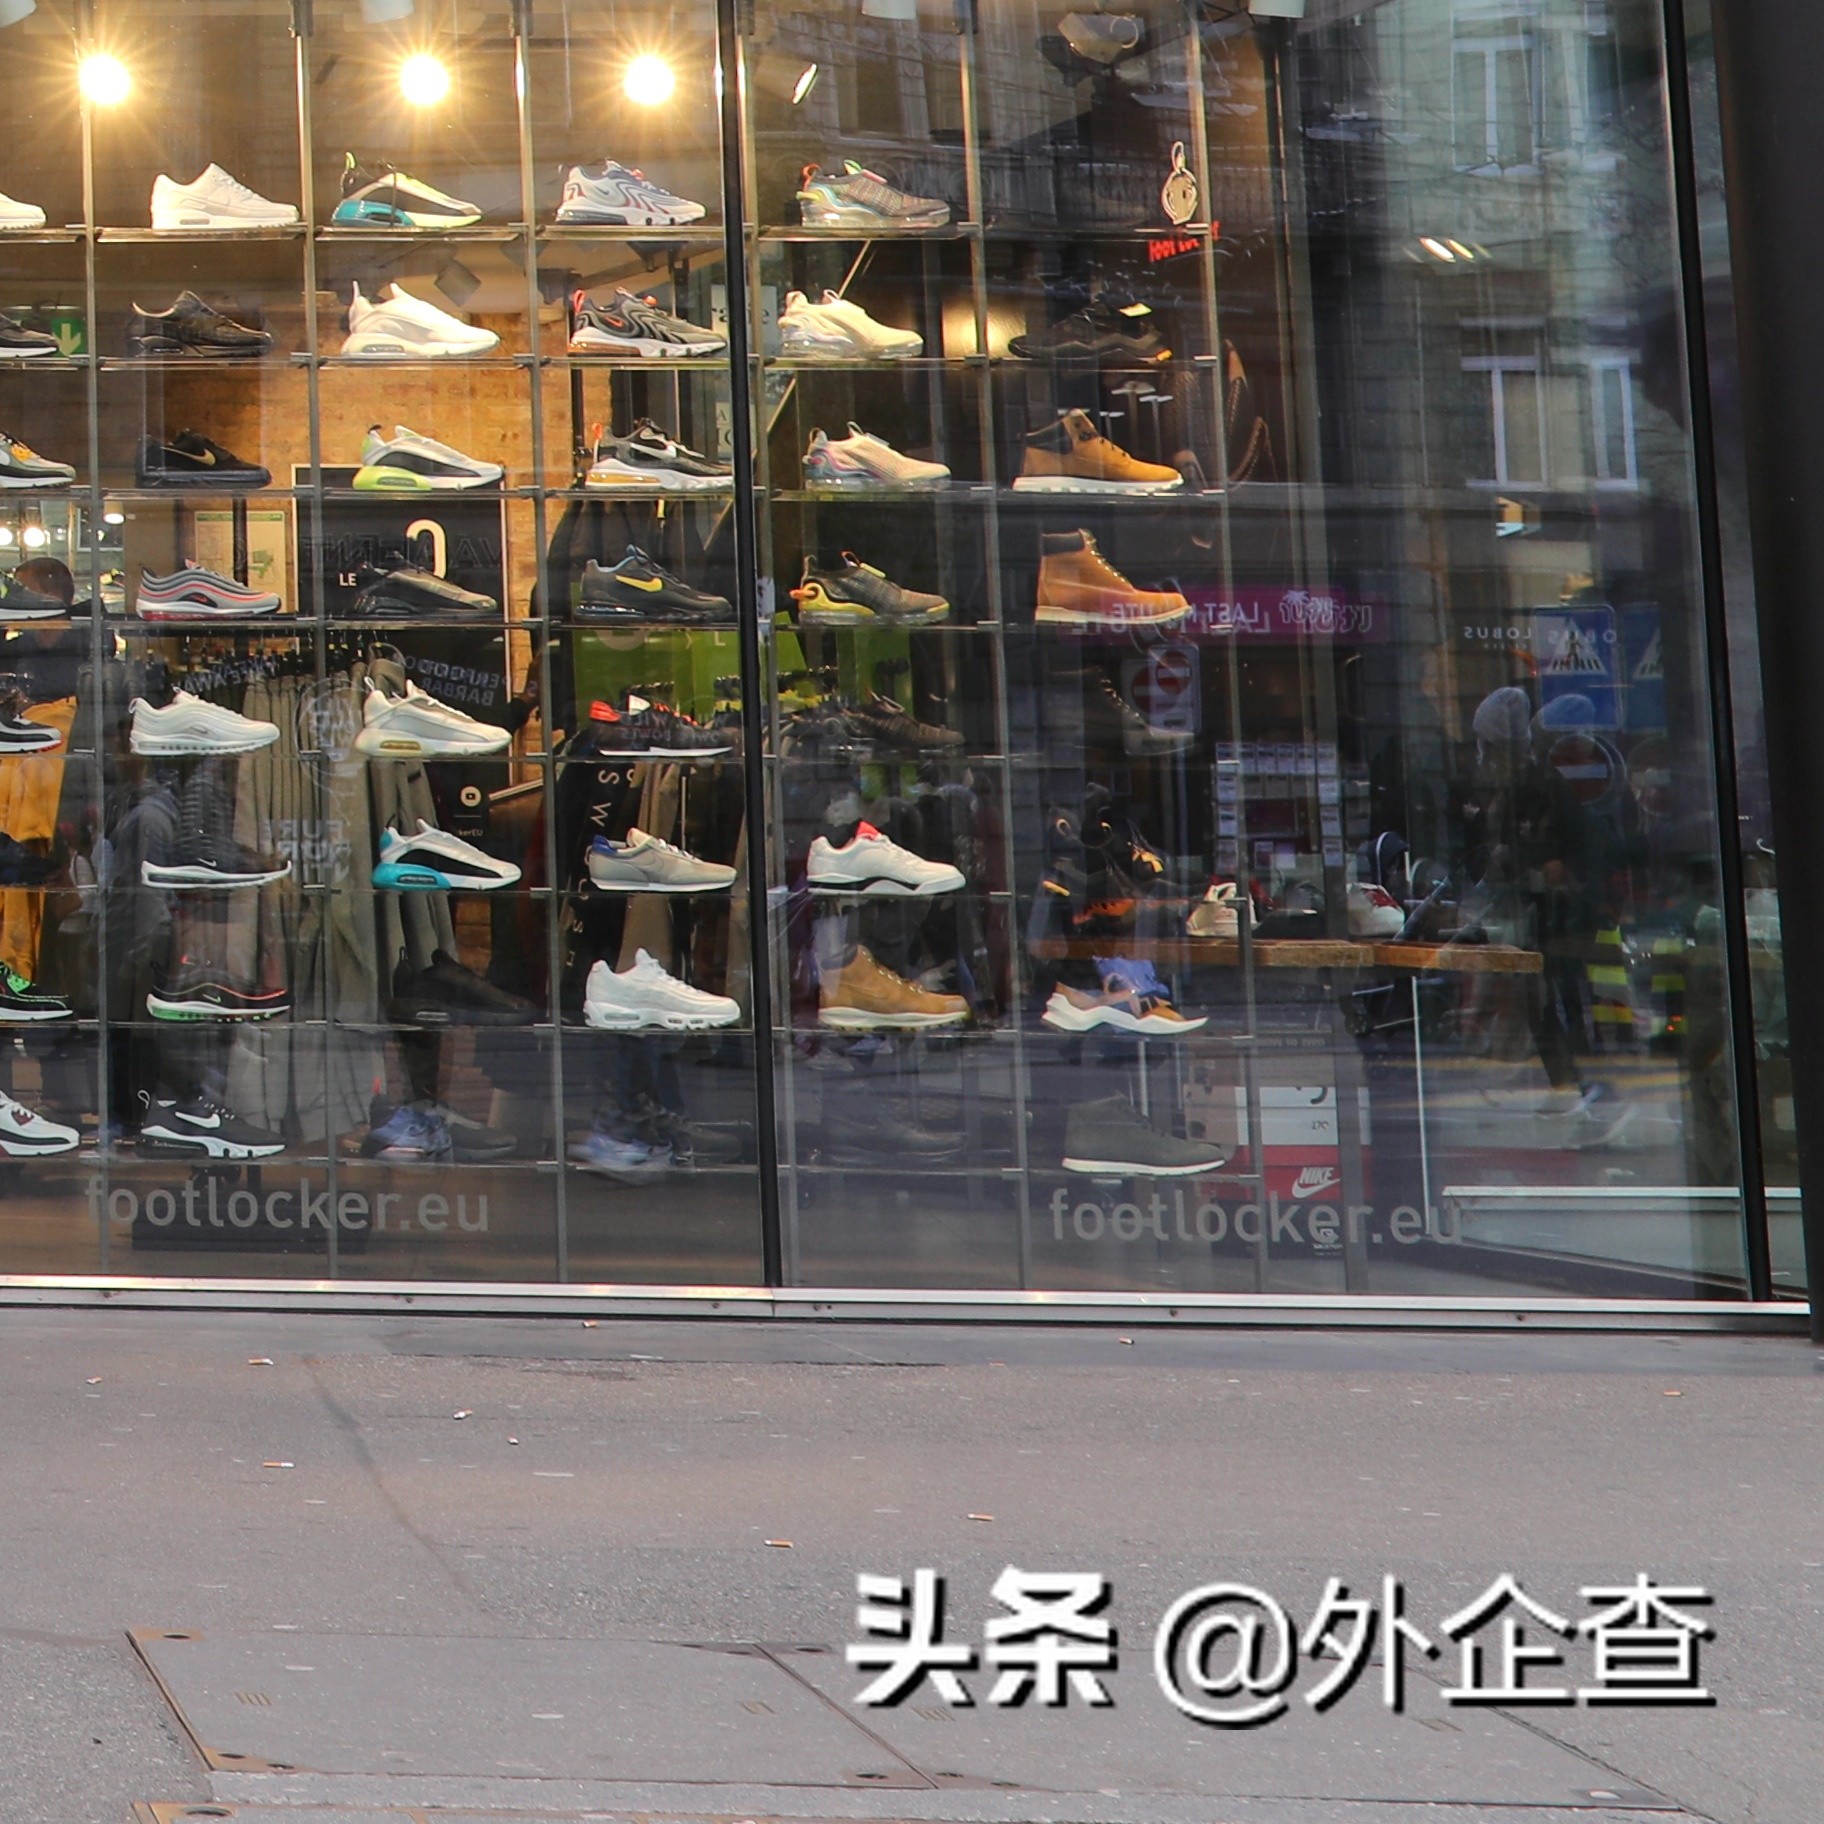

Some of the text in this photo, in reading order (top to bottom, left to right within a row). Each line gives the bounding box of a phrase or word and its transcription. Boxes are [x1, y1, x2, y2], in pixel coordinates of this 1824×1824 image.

[1300, 1167, 1335, 1184] NIKE
[86, 1177, 489, 1233] footlocker.eu
[1049, 1189, 1462, 1247] footlocker.eu
